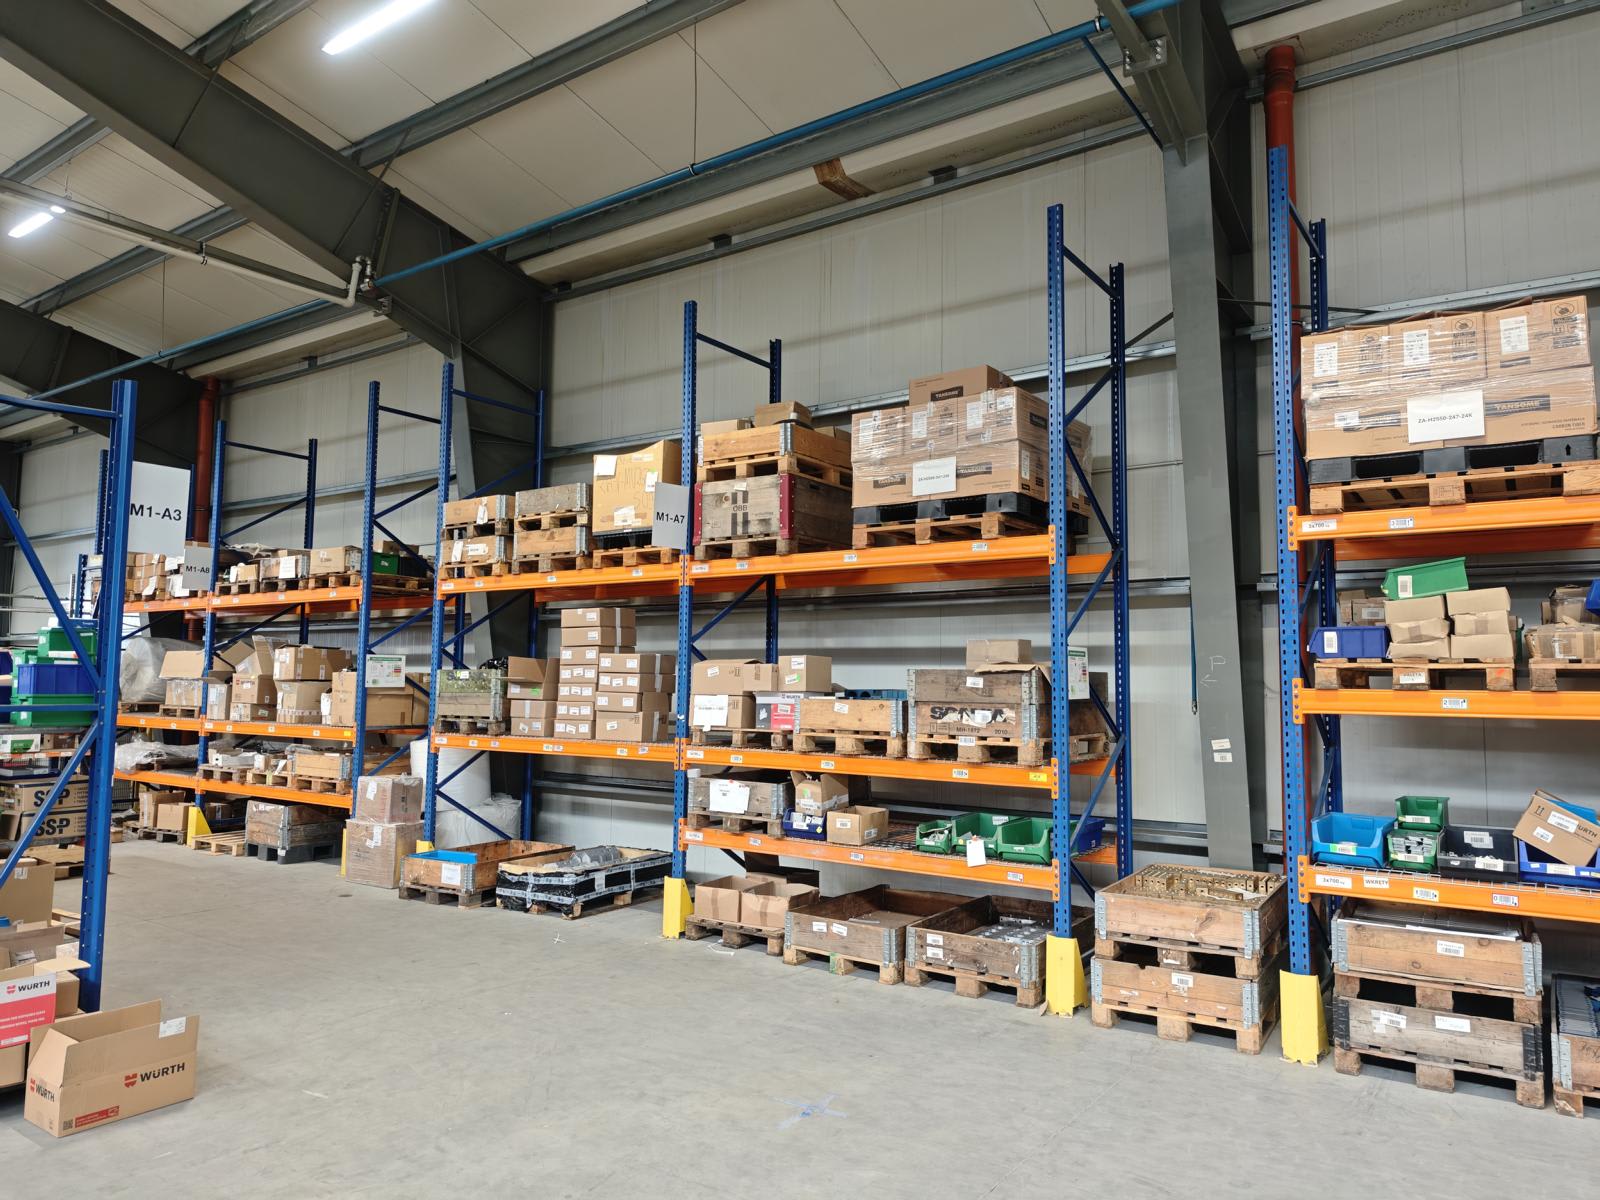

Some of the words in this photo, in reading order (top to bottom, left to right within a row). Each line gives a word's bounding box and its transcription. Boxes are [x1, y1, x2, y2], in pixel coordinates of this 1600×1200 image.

[130, 503, 182, 521] M1-A3
[656, 512, 685, 524] M1-A7
[34, 788, 71, 807] SP
[18, 980, 50, 992] WÜRTH
[140, 1062, 186, 1083] WÜRTH
[35, 1083, 55, 1102] WÜRTH
